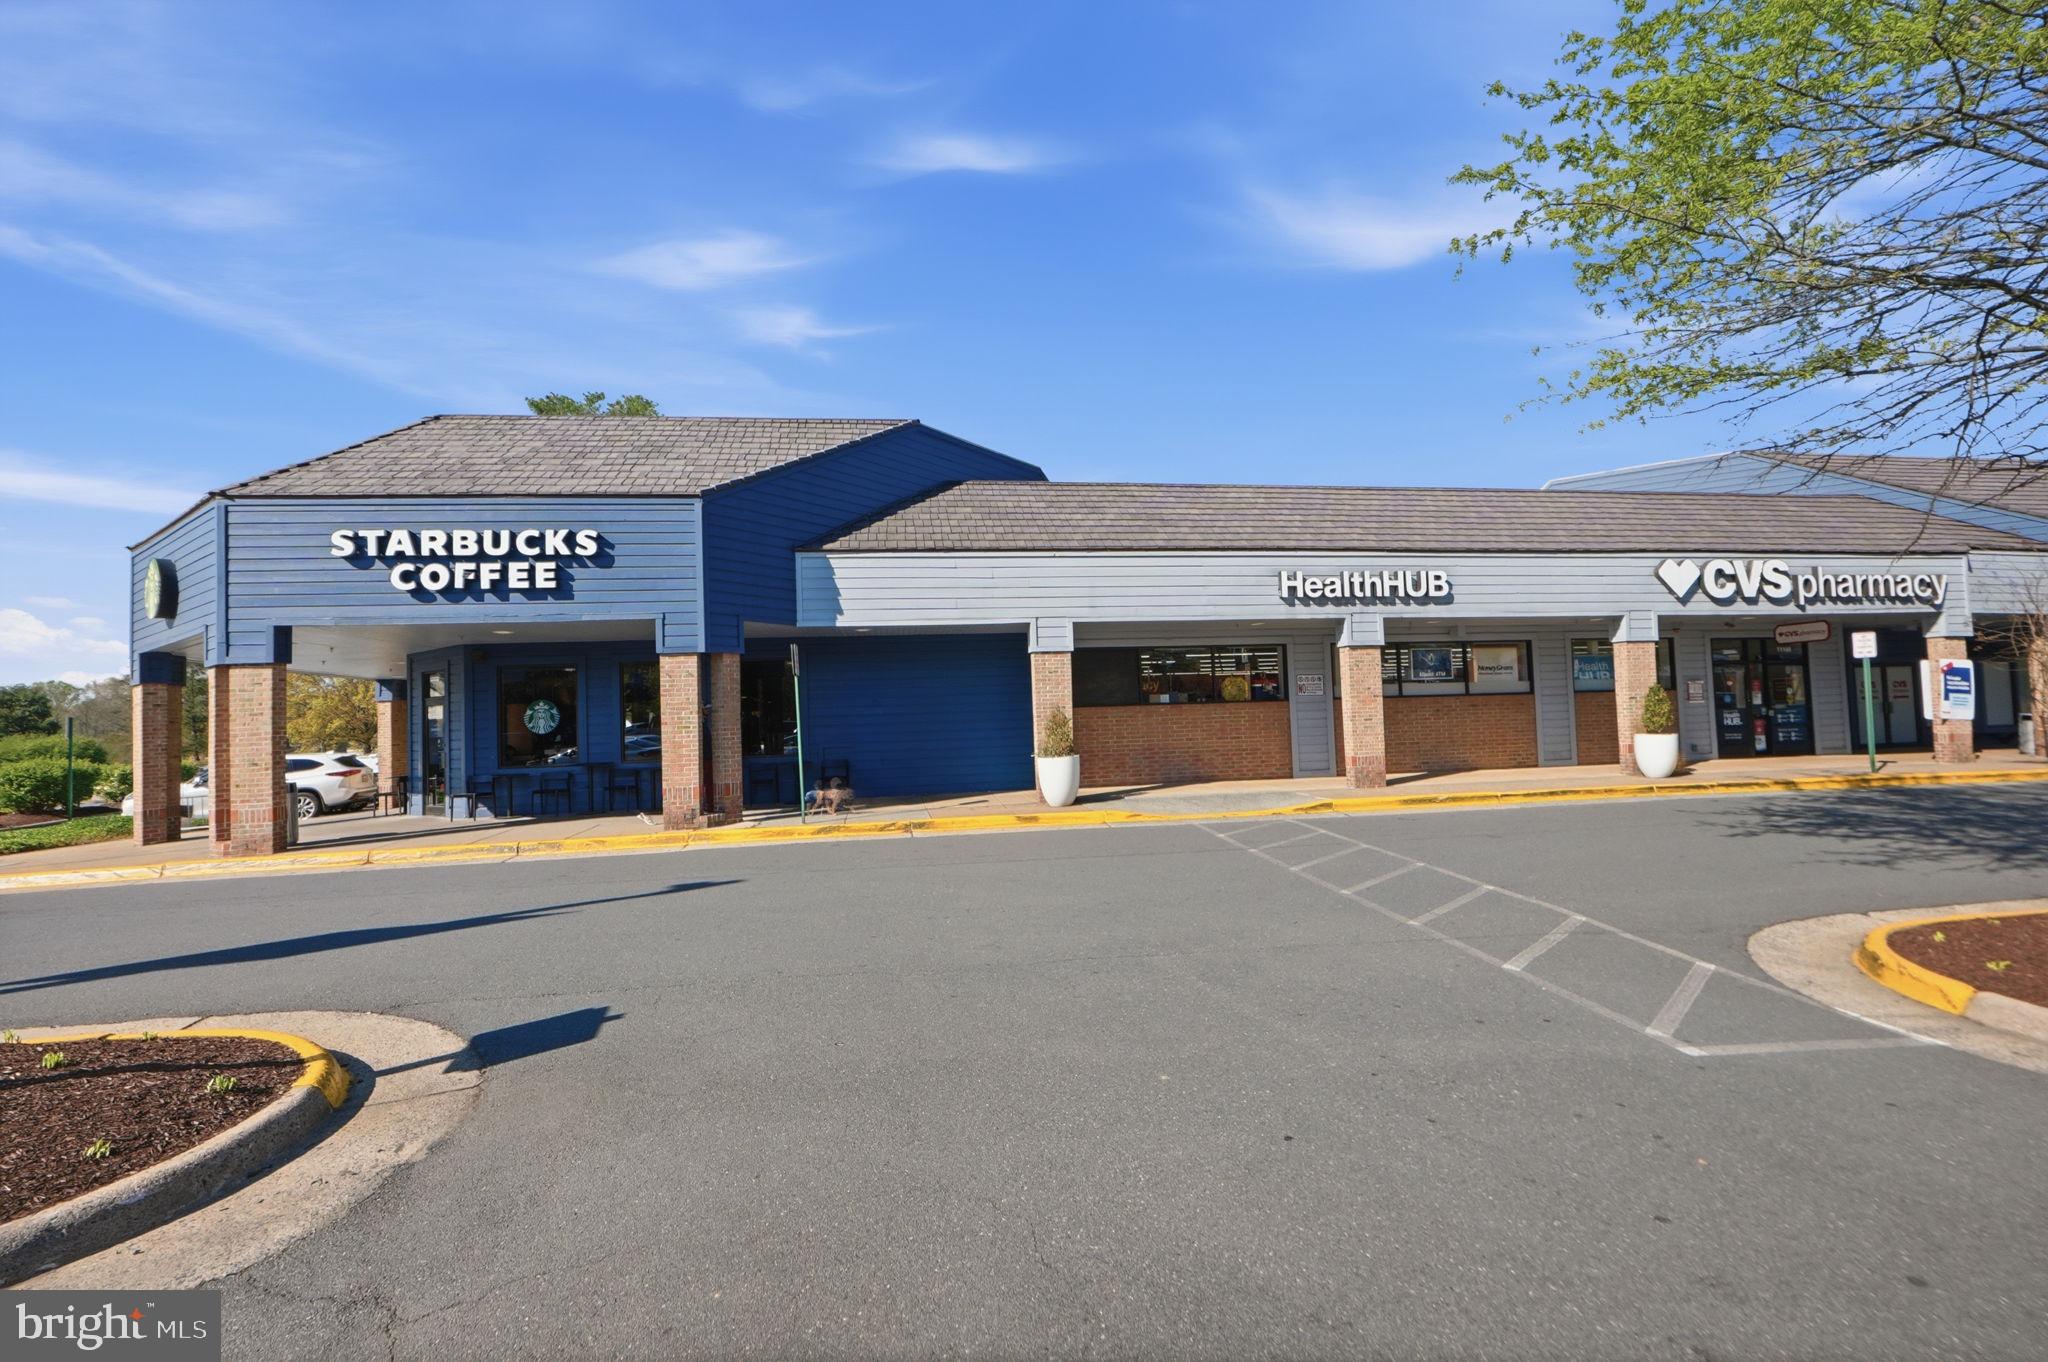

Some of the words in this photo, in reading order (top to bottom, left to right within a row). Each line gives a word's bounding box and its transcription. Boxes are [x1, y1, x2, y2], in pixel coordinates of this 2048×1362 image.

[331, 529, 598, 556] STARBUCKS
[390, 561, 557, 591] COFFEE
[1279, 570, 1450, 598] HealthHUB
[1703, 559, 1792, 598] CVS
[1798, 566, 1947, 605] pharmacy
